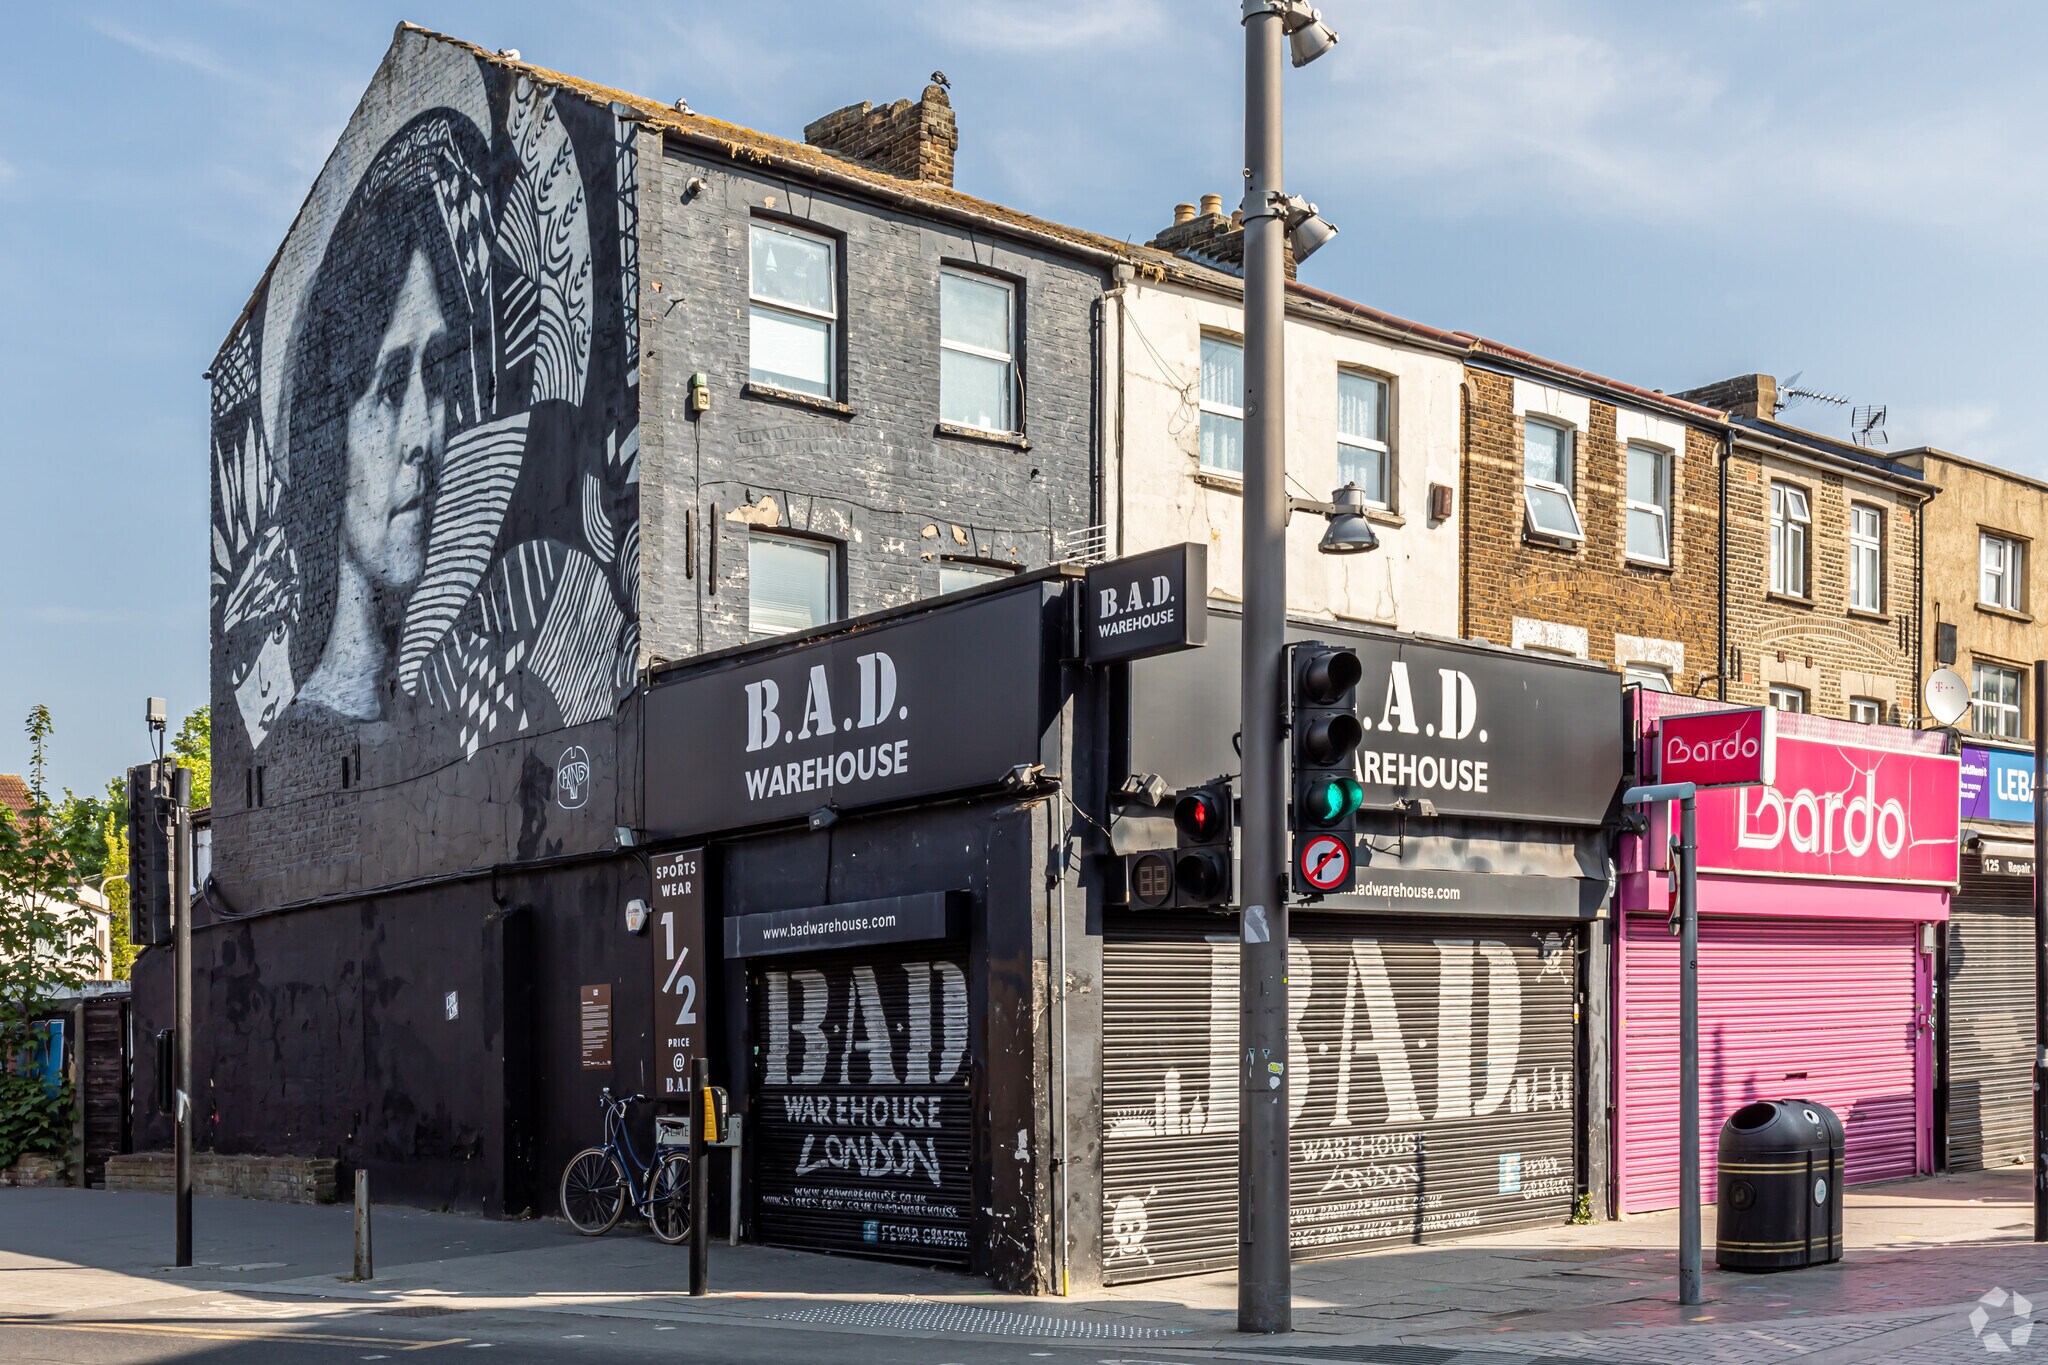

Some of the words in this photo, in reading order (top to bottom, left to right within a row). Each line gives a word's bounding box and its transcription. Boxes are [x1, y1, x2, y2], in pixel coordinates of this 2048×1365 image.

[1100, 576, 1175, 618] B.A.D.
[1099, 609, 1174, 638] WAREHOUSE
[745, 652, 908, 752] B.A.D.
[1354, 661, 1488, 743] .A.D.
[1667, 731, 1759, 764] Bardo
[745, 740, 908, 801] WAREHOUSE
[1353, 750, 1488, 793] AREHOUSE
[1960, 764, 1987, 777] orldRemit
[1739, 770, 1905, 859] Bardo
[656, 861, 696, 879] SPORTS
[1985, 859, 1999, 872] 125
[2008, 861, 2030, 876] Repair
[661, 882, 692, 897] WEAR
[763, 915, 896, 939] www.badwarehouse.com
[668, 1038, 690, 1048] PRICE
[673, 1053, 685, 1072] @
[784, 1096, 941, 1128] WAREHOUSE
[796, 1132, 942, 1188] LONDON
[1301, 1133, 1427, 1163] WAREHOUSE
[1317, 1163, 1420, 1195] LONDON
